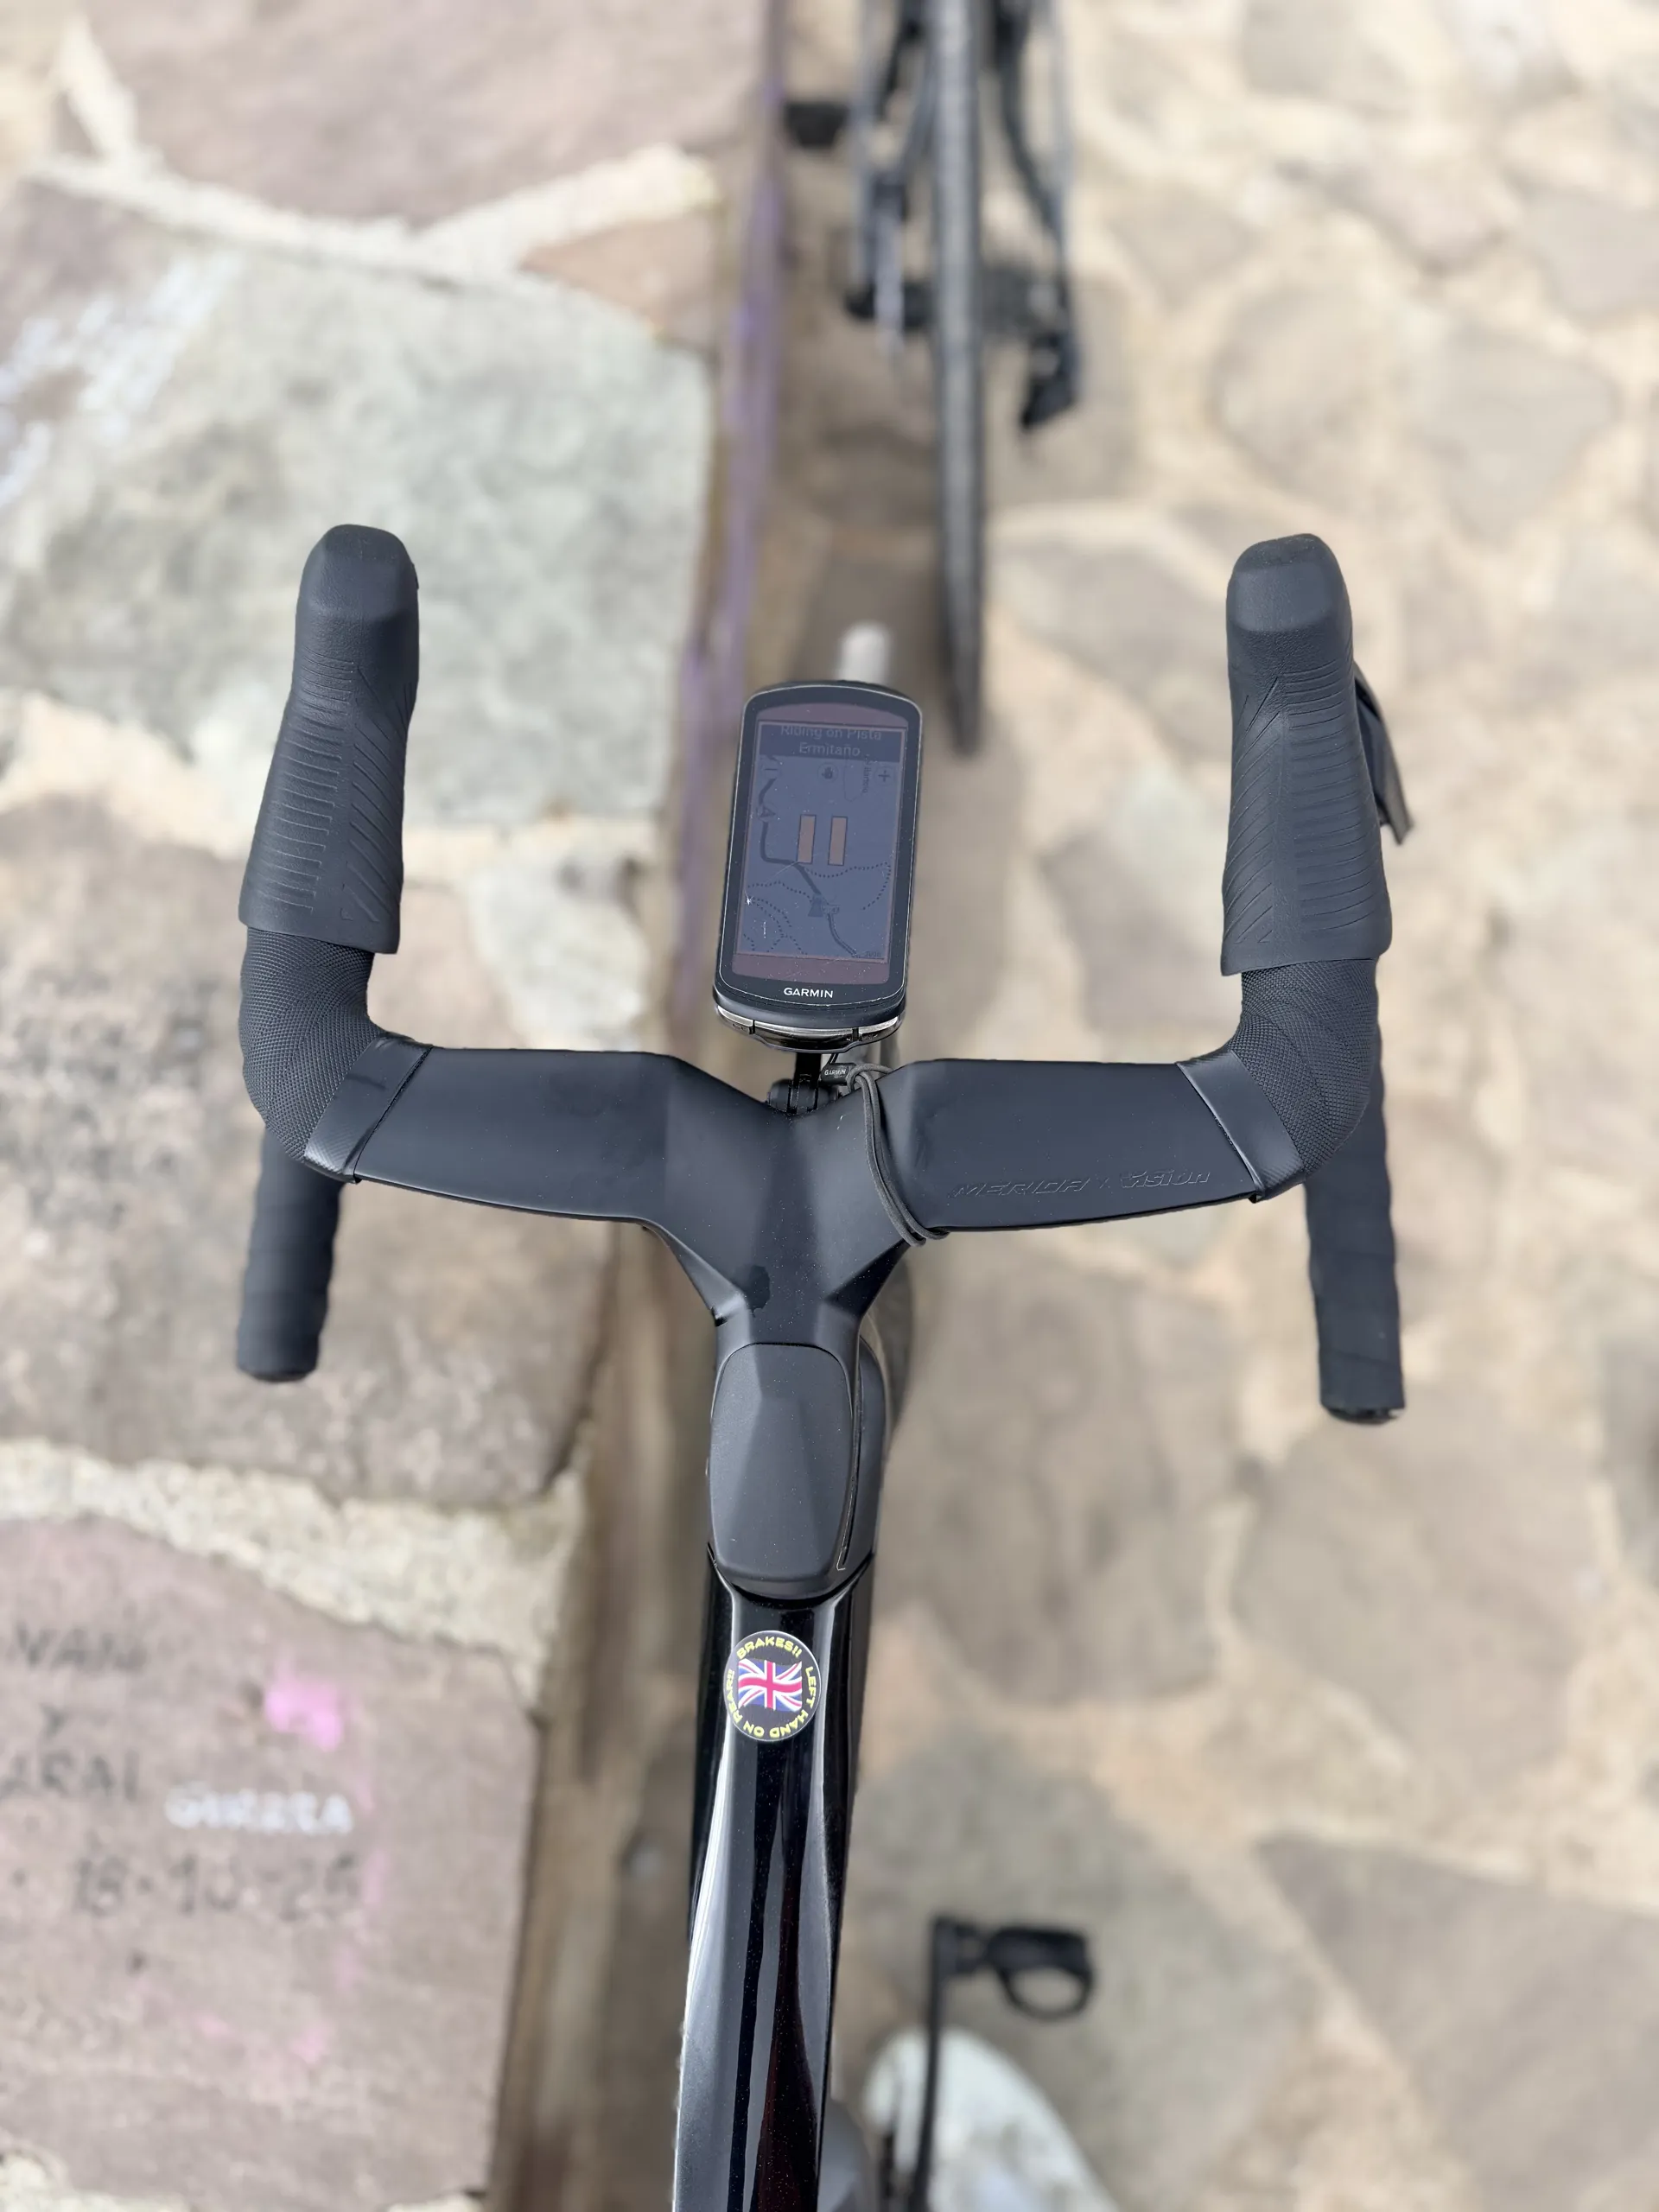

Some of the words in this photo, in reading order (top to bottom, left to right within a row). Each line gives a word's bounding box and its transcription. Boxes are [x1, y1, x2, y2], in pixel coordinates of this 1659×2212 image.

[780, 725, 822, 740] Riding
[826, 729, 842, 738] on
[847, 729, 882, 741] Pista
[798, 741, 861, 757] Ermitaño
[783, 987, 833, 999] GARMIN
[946, 1178, 1091, 1198] MERIDA
[736, 1636, 802, 1659] BRAKES!!
[726, 1669, 743, 1724] REAR!!
[805, 1666, 817, 1708] LEFT
[742, 1720, 765, 1738] ON
[769, 1709, 809, 1738] HAND
